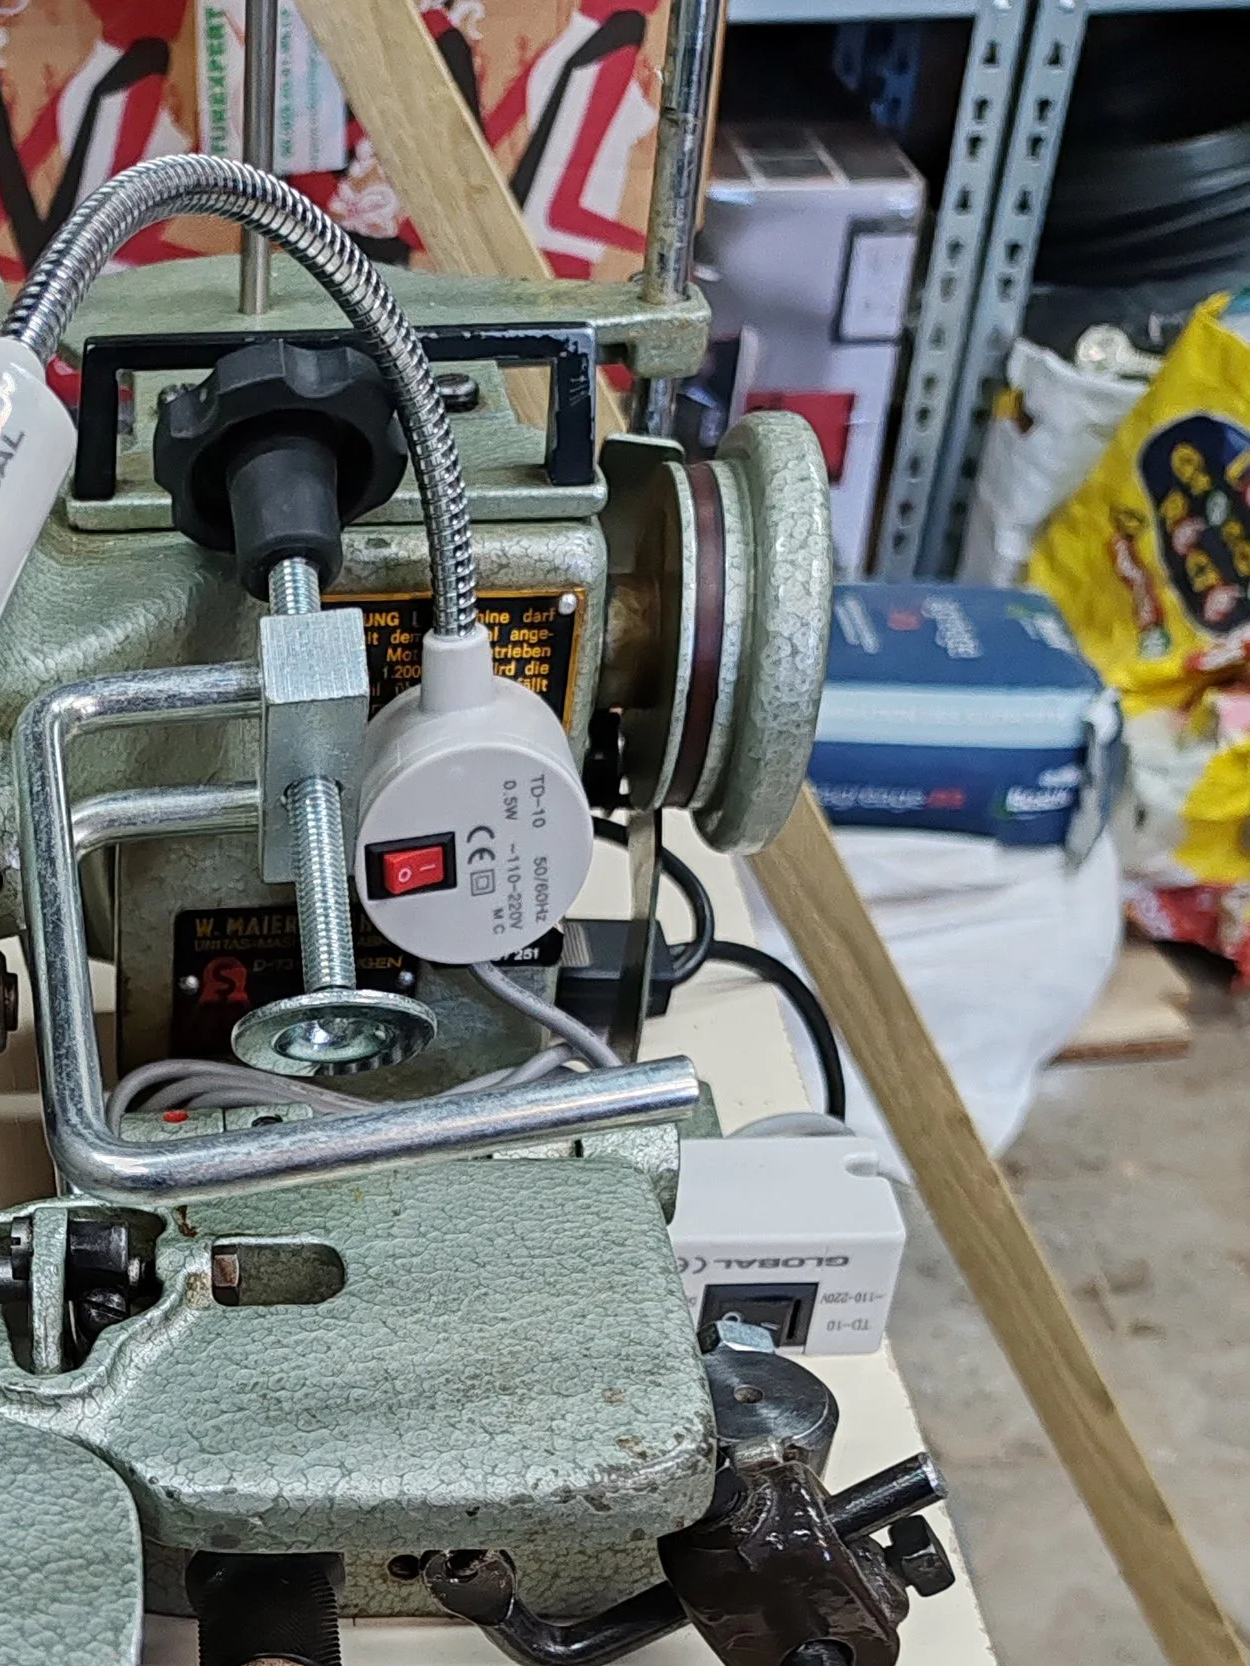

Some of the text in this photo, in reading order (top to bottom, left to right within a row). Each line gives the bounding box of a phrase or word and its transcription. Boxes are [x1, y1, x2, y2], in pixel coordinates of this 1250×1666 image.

[522, 608, 556, 622] darf
[509, 630, 554, 644] ange-
[524, 661, 550, 675] die
[503, 780, 518, 821] 0.5W
[530, 773, 550, 923] TD-10 50/60Hz
[714, 1256, 850, 1270] GLOBAL
[826, 1318, 871, 1332] TD-10
